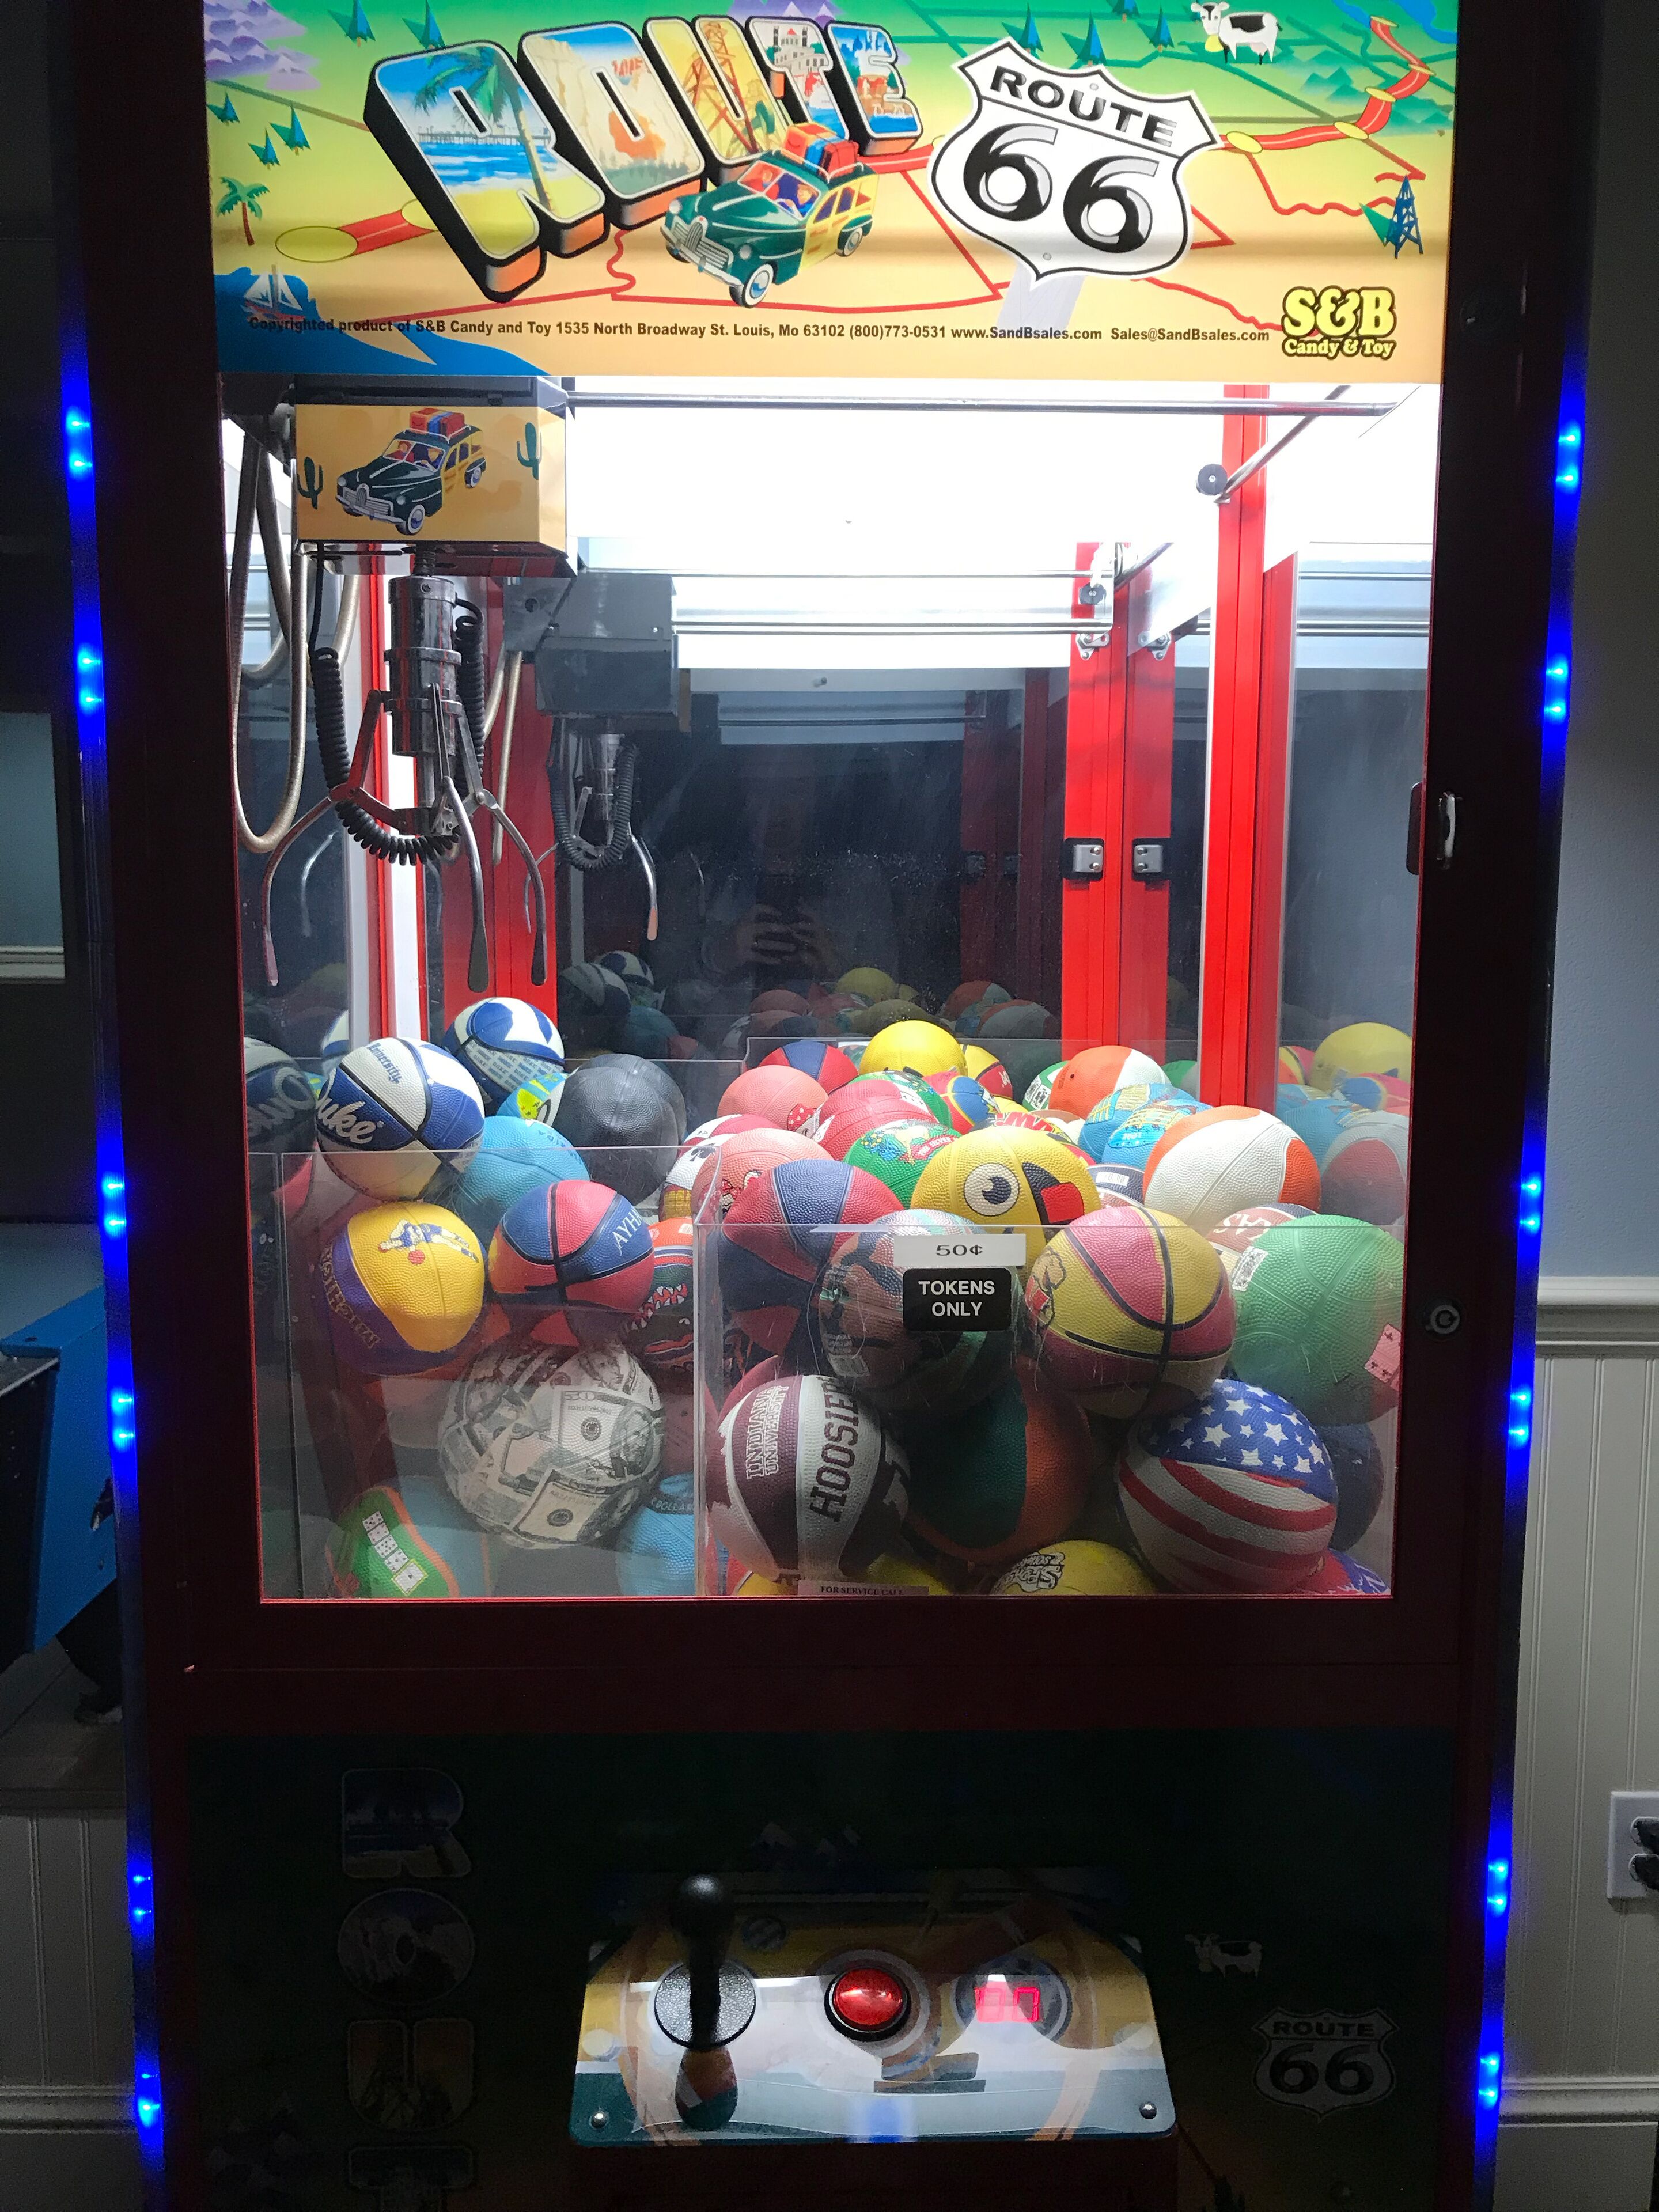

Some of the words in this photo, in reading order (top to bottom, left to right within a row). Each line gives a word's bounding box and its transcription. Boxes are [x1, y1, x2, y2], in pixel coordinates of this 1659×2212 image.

[990, 65, 1177, 147] ROUTE
[365, 15, 924, 303] ROUTE
[963, 123, 1160, 253] 66
[249, 317, 334, 332] Copyrighted
[339, 320, 393, 334] product
[397, 320, 410, 332] of
[416, 320, 445, 332] S&B
[451, 321, 493, 335] Candy
[498, 321, 522, 334] and
[527, 321, 551, 336] Toy
[556, 322, 589, 334] 1535
[594, 323, 632, 335] North
[638, 323, 706, 338] Broadway
[710, 323, 729, 335] St.
[734, 324, 774, 338] Louis,
[779, 324, 799, 336] Mo
[803, 324, 845, 337] 63102
[850, 324, 945, 340] (800)773-0531
[951, 326, 1102, 340] www.SandBsales.com
[1111, 327, 1269, 342] Sales@SandBsales.com
[1282, 285, 1397, 338] S&B
[1282, 336, 1341, 359] Candy
[1342, 338, 1361, 357] &
[1361, 337, 1397, 360] Toy
[935, 1244, 983, 1256] 50¢
[918, 1280, 995, 1296] TOKENS
[931, 1301, 983, 1317] ONLY
[745, 1386, 777, 1480] INDIANA
[764, 1385, 790, 1476] UNIVERSITY
[1273, 2021, 1374, 2036] ROUTE
[1270, 2043, 1374, 2096] 66
